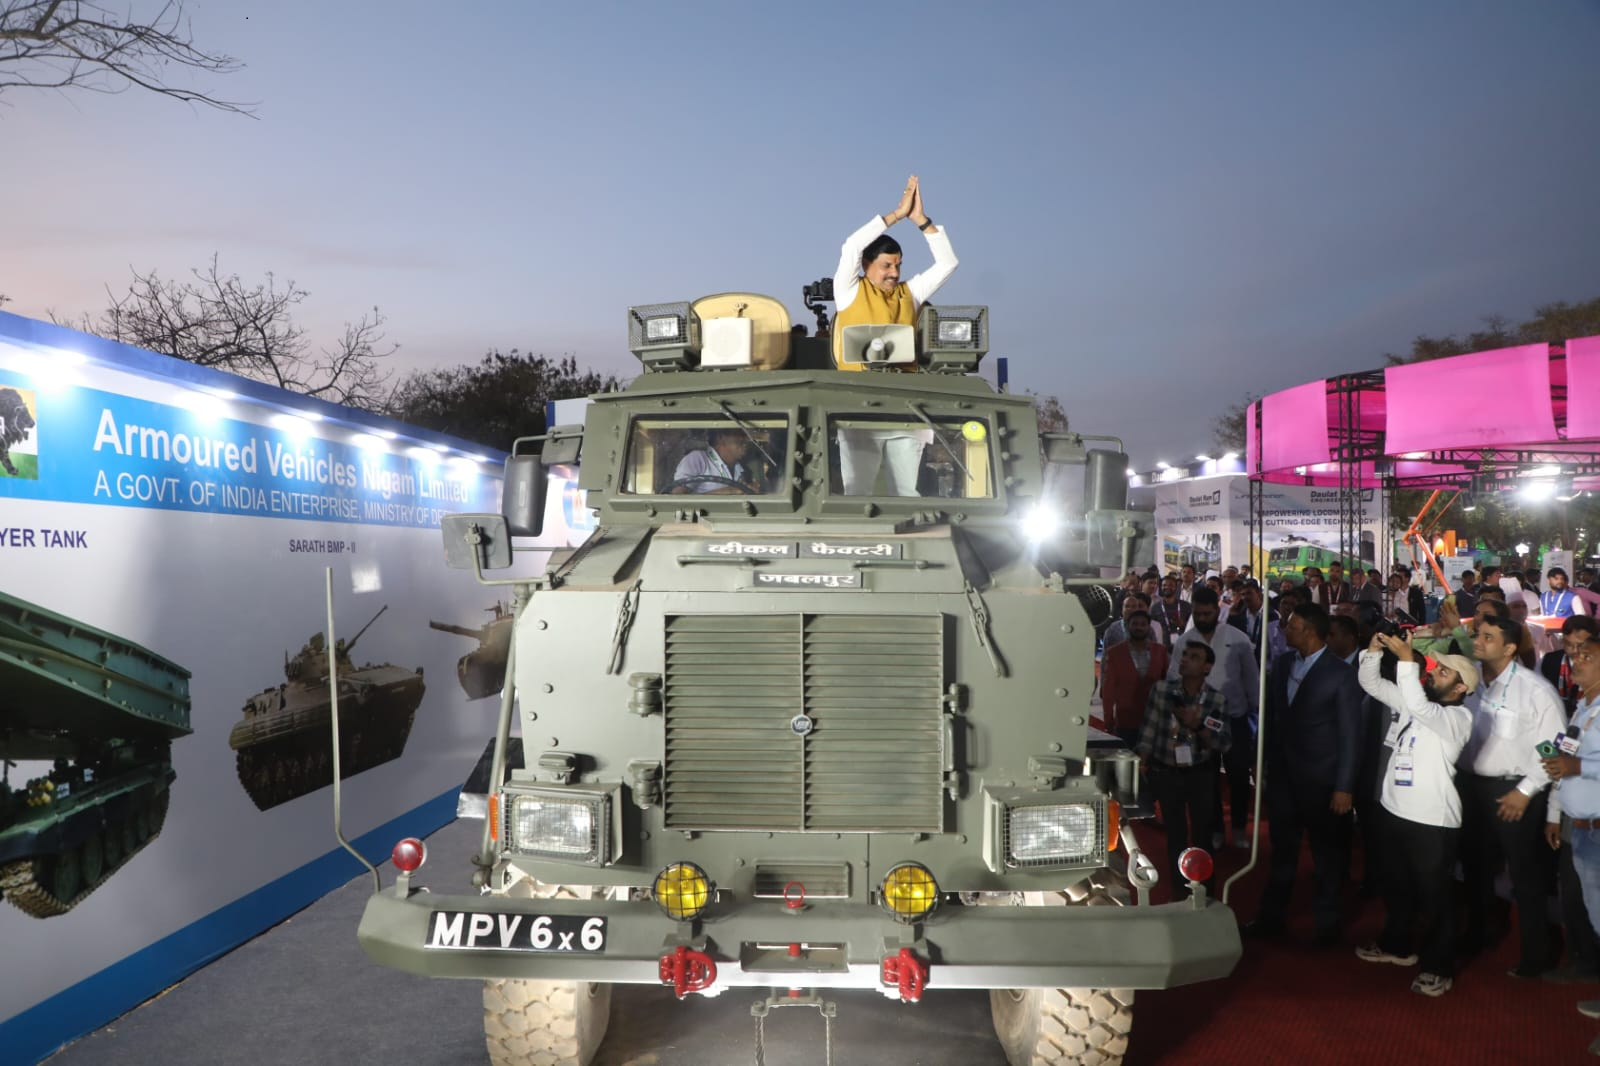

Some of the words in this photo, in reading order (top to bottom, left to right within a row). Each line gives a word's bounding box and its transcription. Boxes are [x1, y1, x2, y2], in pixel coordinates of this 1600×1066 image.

[93, 408, 257, 474] Armoured
[264, 440, 358, 488] Vehicles
[362, 458, 415, 499] Nigam
[419, 470, 469, 503] Limited
[94, 470, 112, 498] A
[116, 472, 183, 504] GOVT.
[189, 480, 216, 506] OF
[222, 484, 268, 512] INDIA
[271, 489, 361, 520] ENTERPRISE,
[364, 501, 415, 522] MINISTRY
[416, 506, 429, 524] OF
[0, 528, 36, 547] YER
[41, 529, 88, 549] TANK
[289, 539, 326, 553] SARATH
[327, 540, 345, 554] BMP
[759, 574, 855, 588] जबलपुर
[432, 911, 522, 948] MPV
